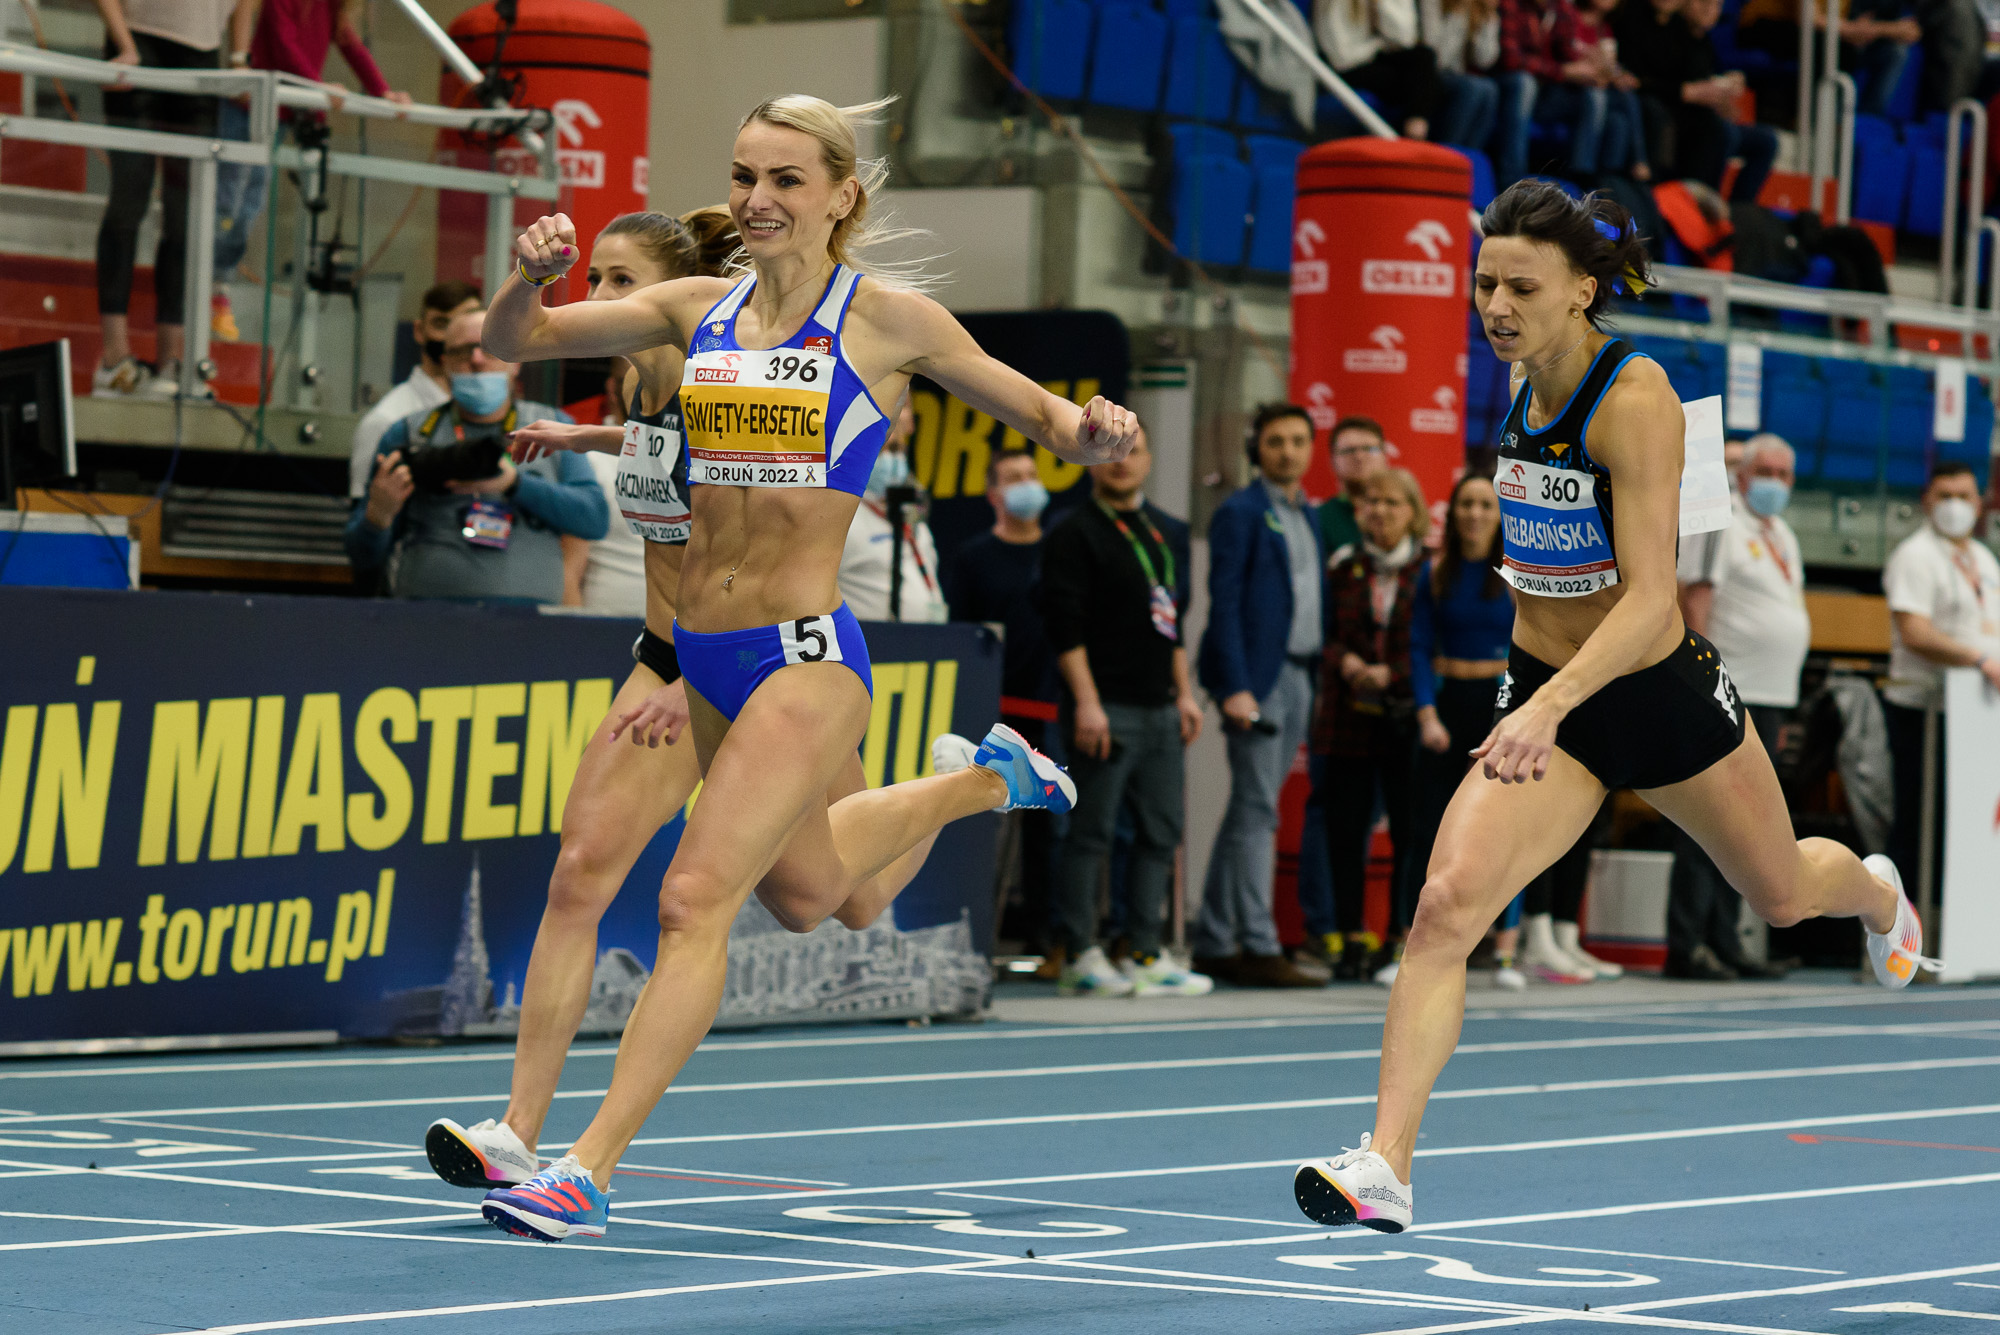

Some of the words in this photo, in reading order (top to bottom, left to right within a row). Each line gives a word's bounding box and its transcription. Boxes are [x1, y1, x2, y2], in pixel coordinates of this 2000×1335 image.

[696, 369, 737, 382] ORLEN
[765, 356, 818, 383] 396
[685, 395, 821, 440] ŚWIĘTY-ERSETIC
[648, 434, 665, 458] 10
[758, 468, 798, 483] 2022
[1541, 474, 1580, 503] 360
[1500, 483, 1526, 499] ORLEN
[1503, 511, 1603, 552] KIEŁBASIŃSKA
[1513, 575, 1552, 593] TORUŃ
[1554, 578, 1593, 593] 2022
[795, 615, 828, 662] 5
[137, 677, 614, 868] MIASTEM
[0, 868, 396, 999] ww.torun.pl
[1370, 1184, 1409, 1210] balance
